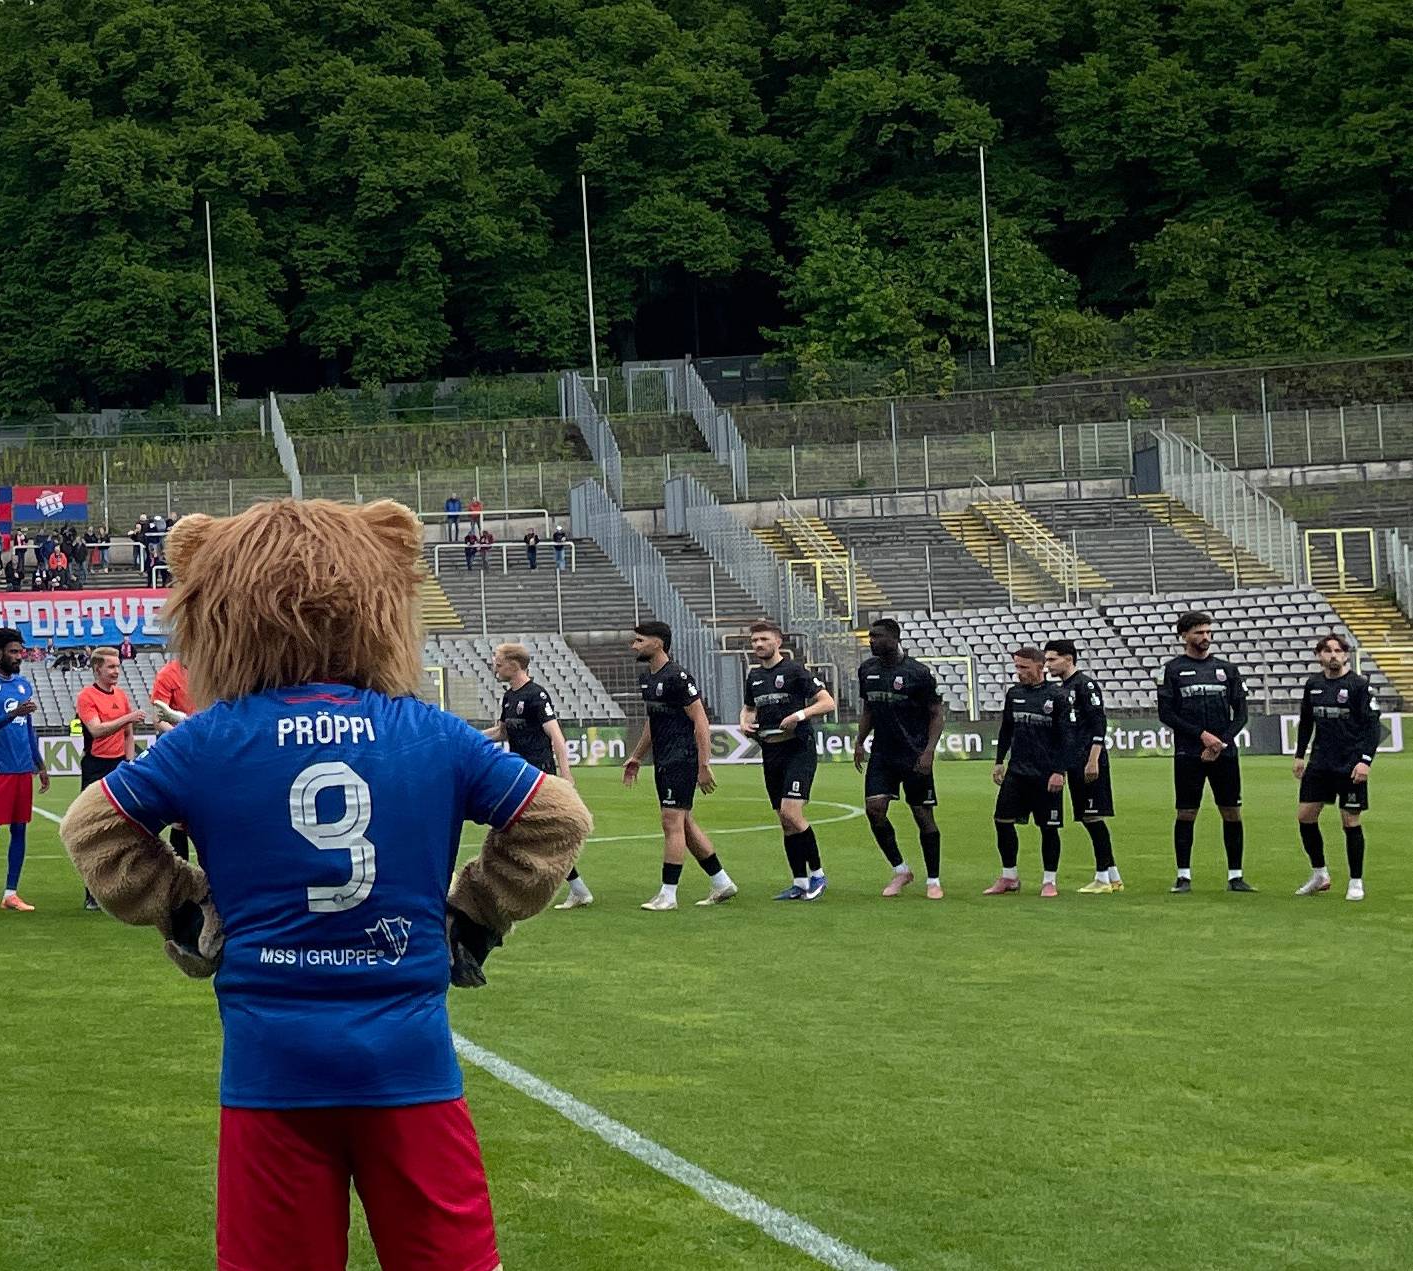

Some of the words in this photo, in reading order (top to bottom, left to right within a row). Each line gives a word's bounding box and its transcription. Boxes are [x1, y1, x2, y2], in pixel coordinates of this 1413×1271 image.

[277, 711, 376, 747] PRÖPPI
[289, 761, 376, 913] 9
[259, 947, 297, 965] MSS
